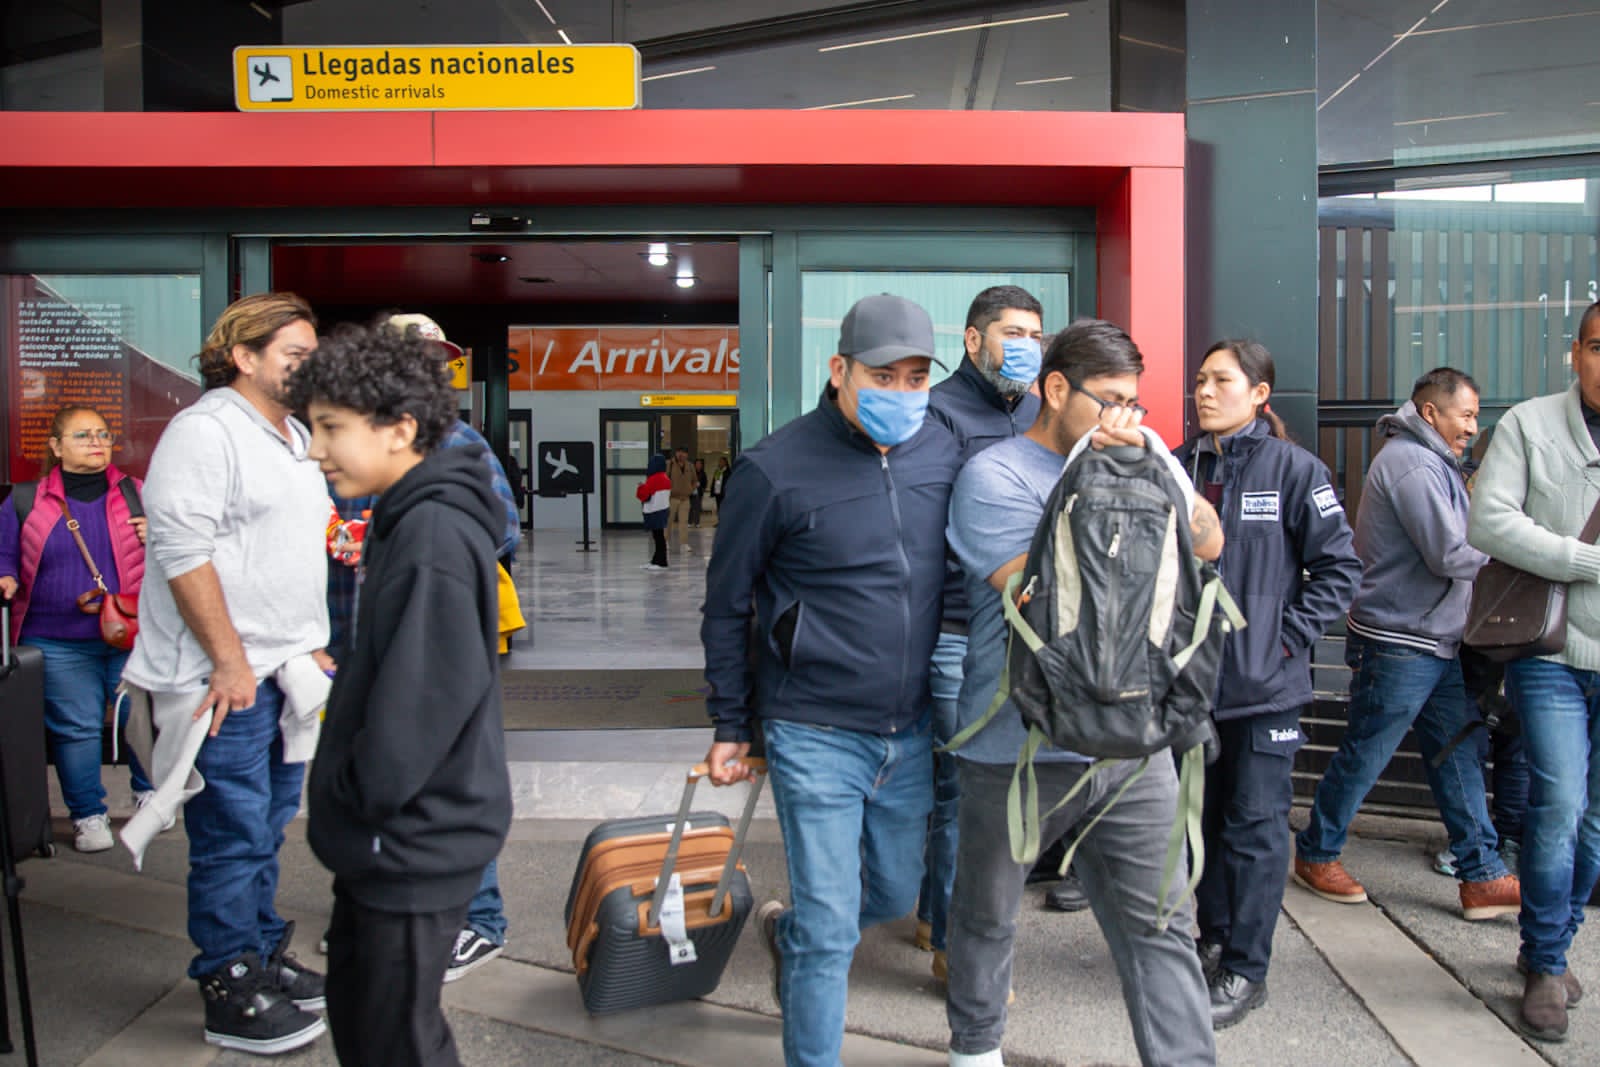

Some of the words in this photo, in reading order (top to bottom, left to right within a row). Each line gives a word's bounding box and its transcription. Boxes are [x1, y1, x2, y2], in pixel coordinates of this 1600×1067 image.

[303, 51, 422, 82] Llegadas
[430, 50, 575, 75] nacionales
[304, 85, 381, 100] Domestic
[385, 84, 446, 99] arrivals
